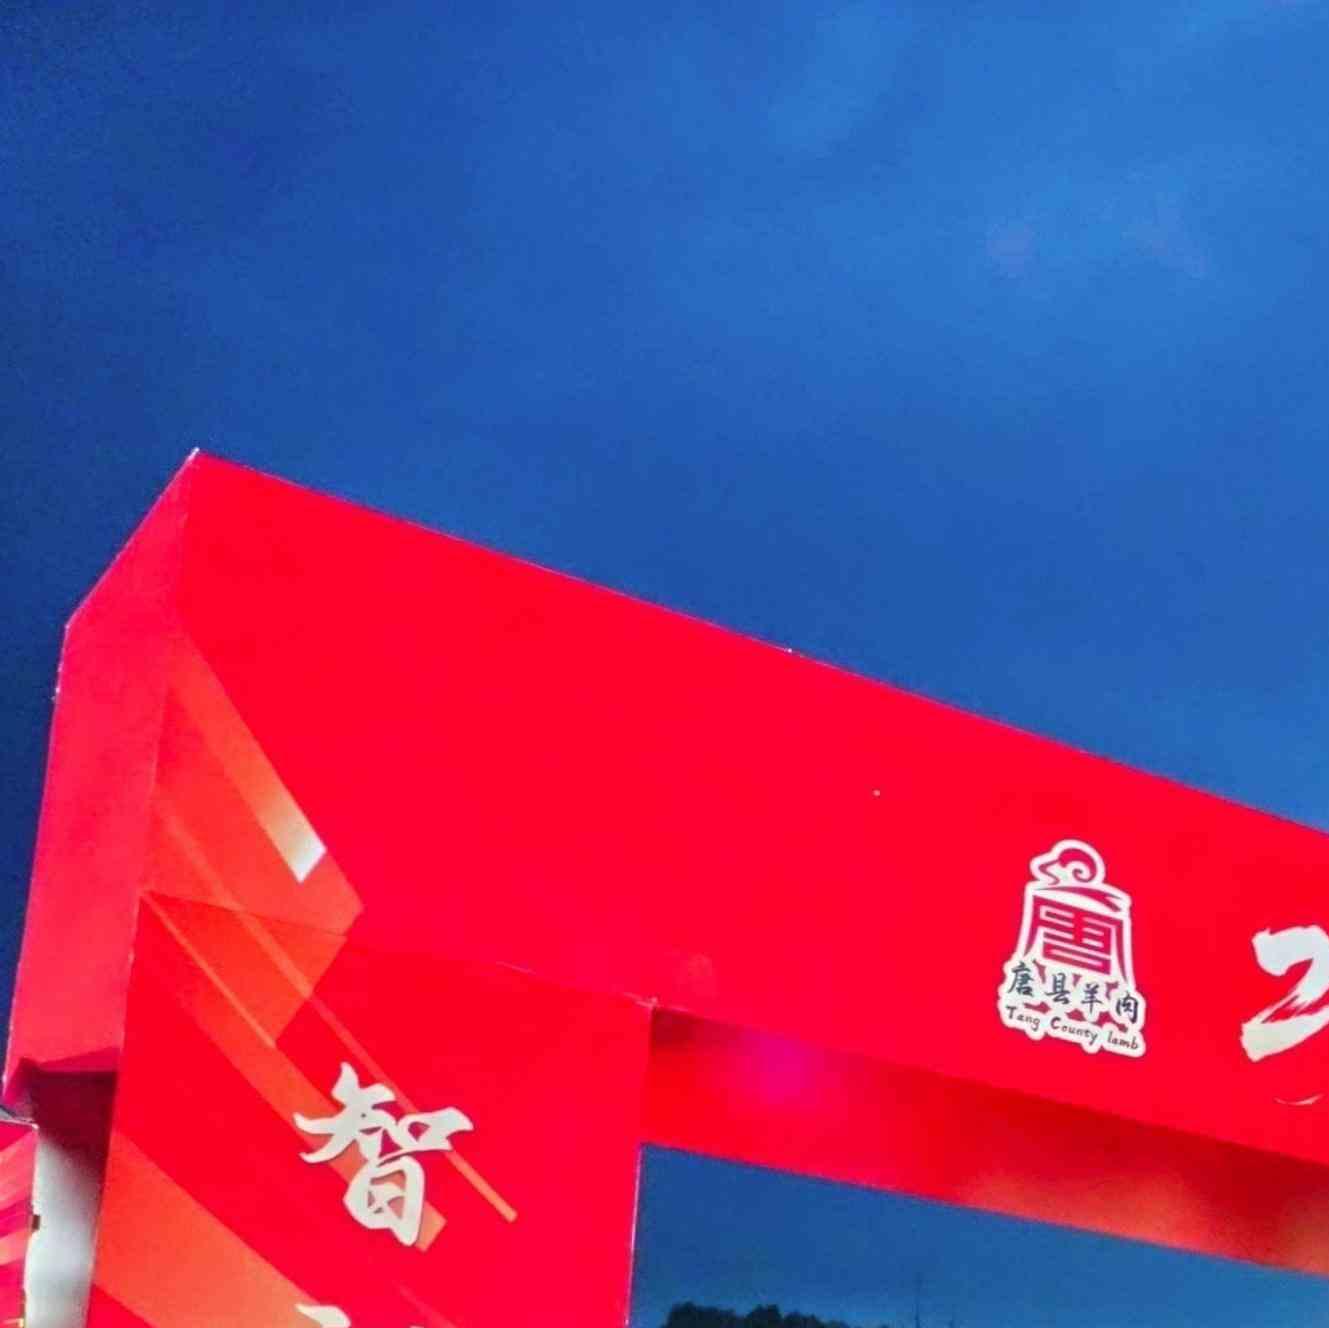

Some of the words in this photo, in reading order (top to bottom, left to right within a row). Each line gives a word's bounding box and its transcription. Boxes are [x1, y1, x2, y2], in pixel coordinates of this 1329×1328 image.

[1007, 960, 1140, 1024] 唐县羊肉
[1005, 1005, 1041, 1032] Tang
[1050, 1016, 1098, 1046] County
